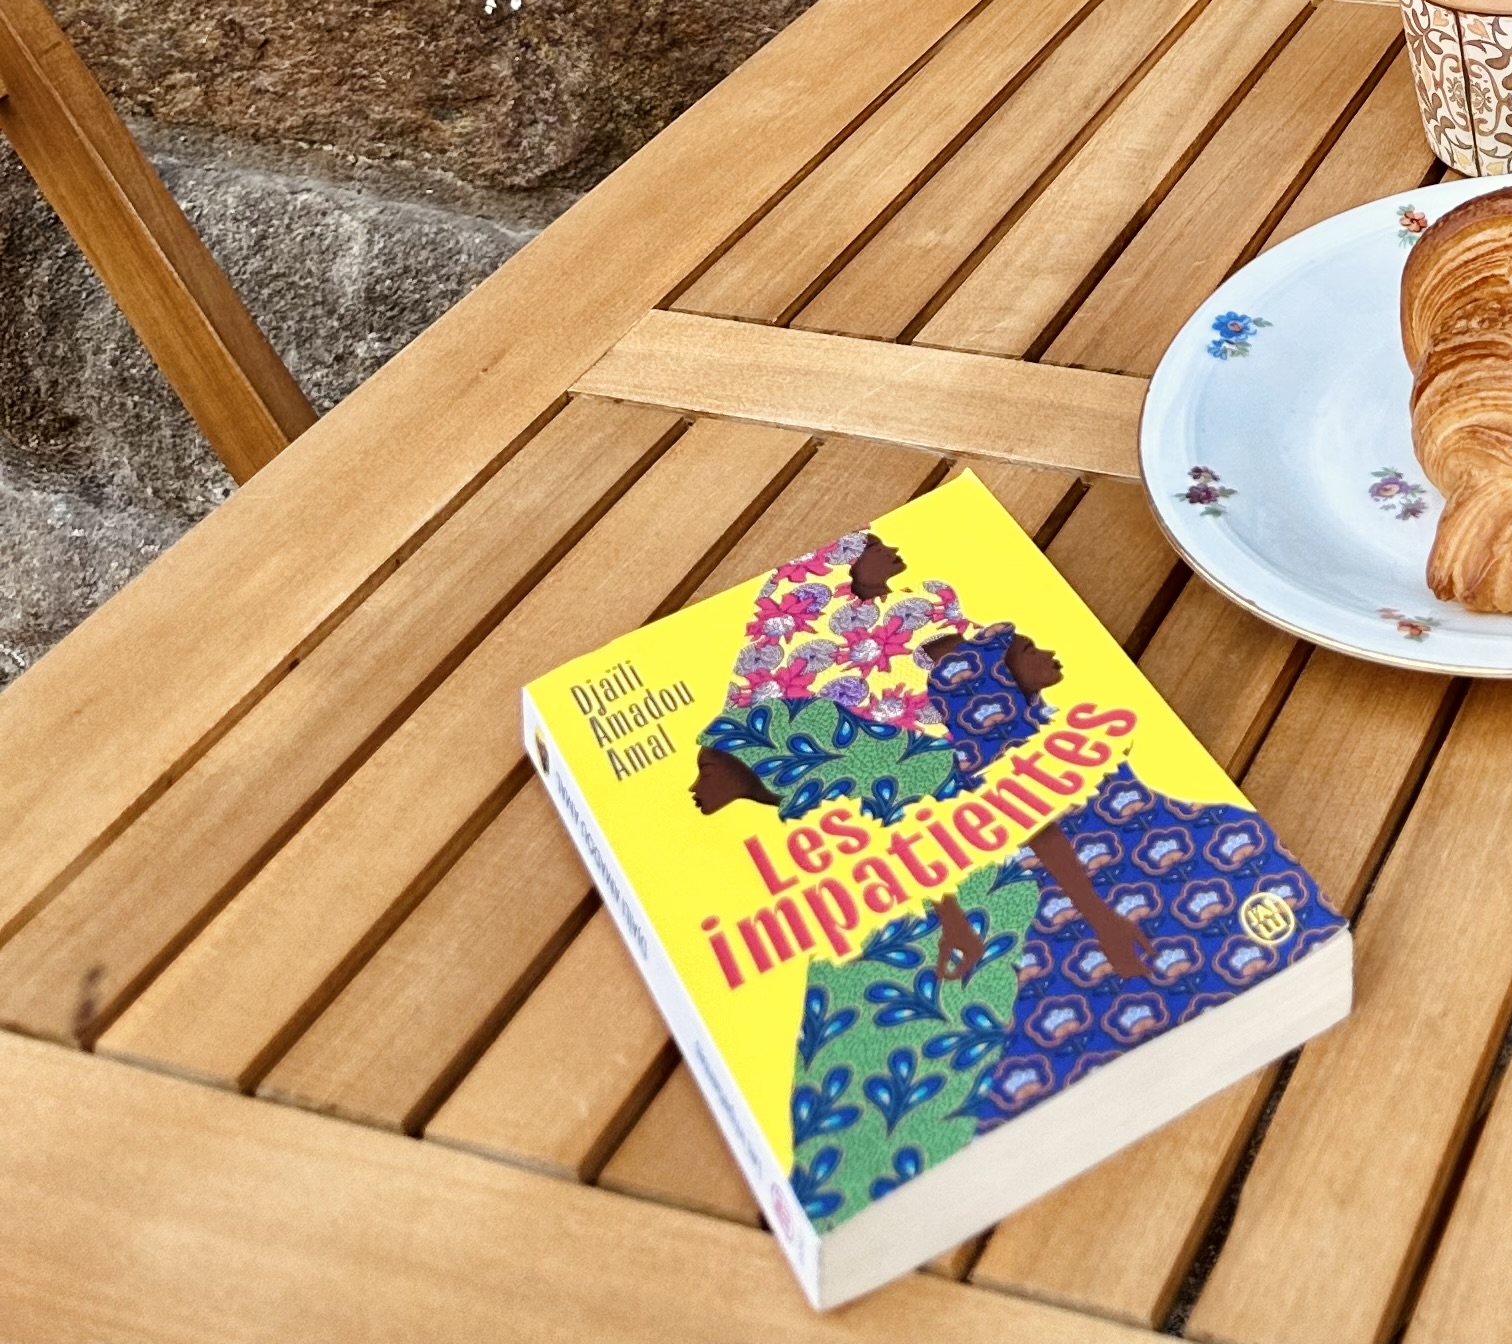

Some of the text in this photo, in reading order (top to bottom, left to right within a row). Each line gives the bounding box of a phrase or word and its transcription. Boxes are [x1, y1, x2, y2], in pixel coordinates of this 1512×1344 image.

[568, 658, 644, 716] Djaïli
[588, 677, 696, 748] Amadou
[605, 732, 678, 783] Amal
[698, 701, 1140, 992] impatientes
[742, 802, 874, 897] Les
